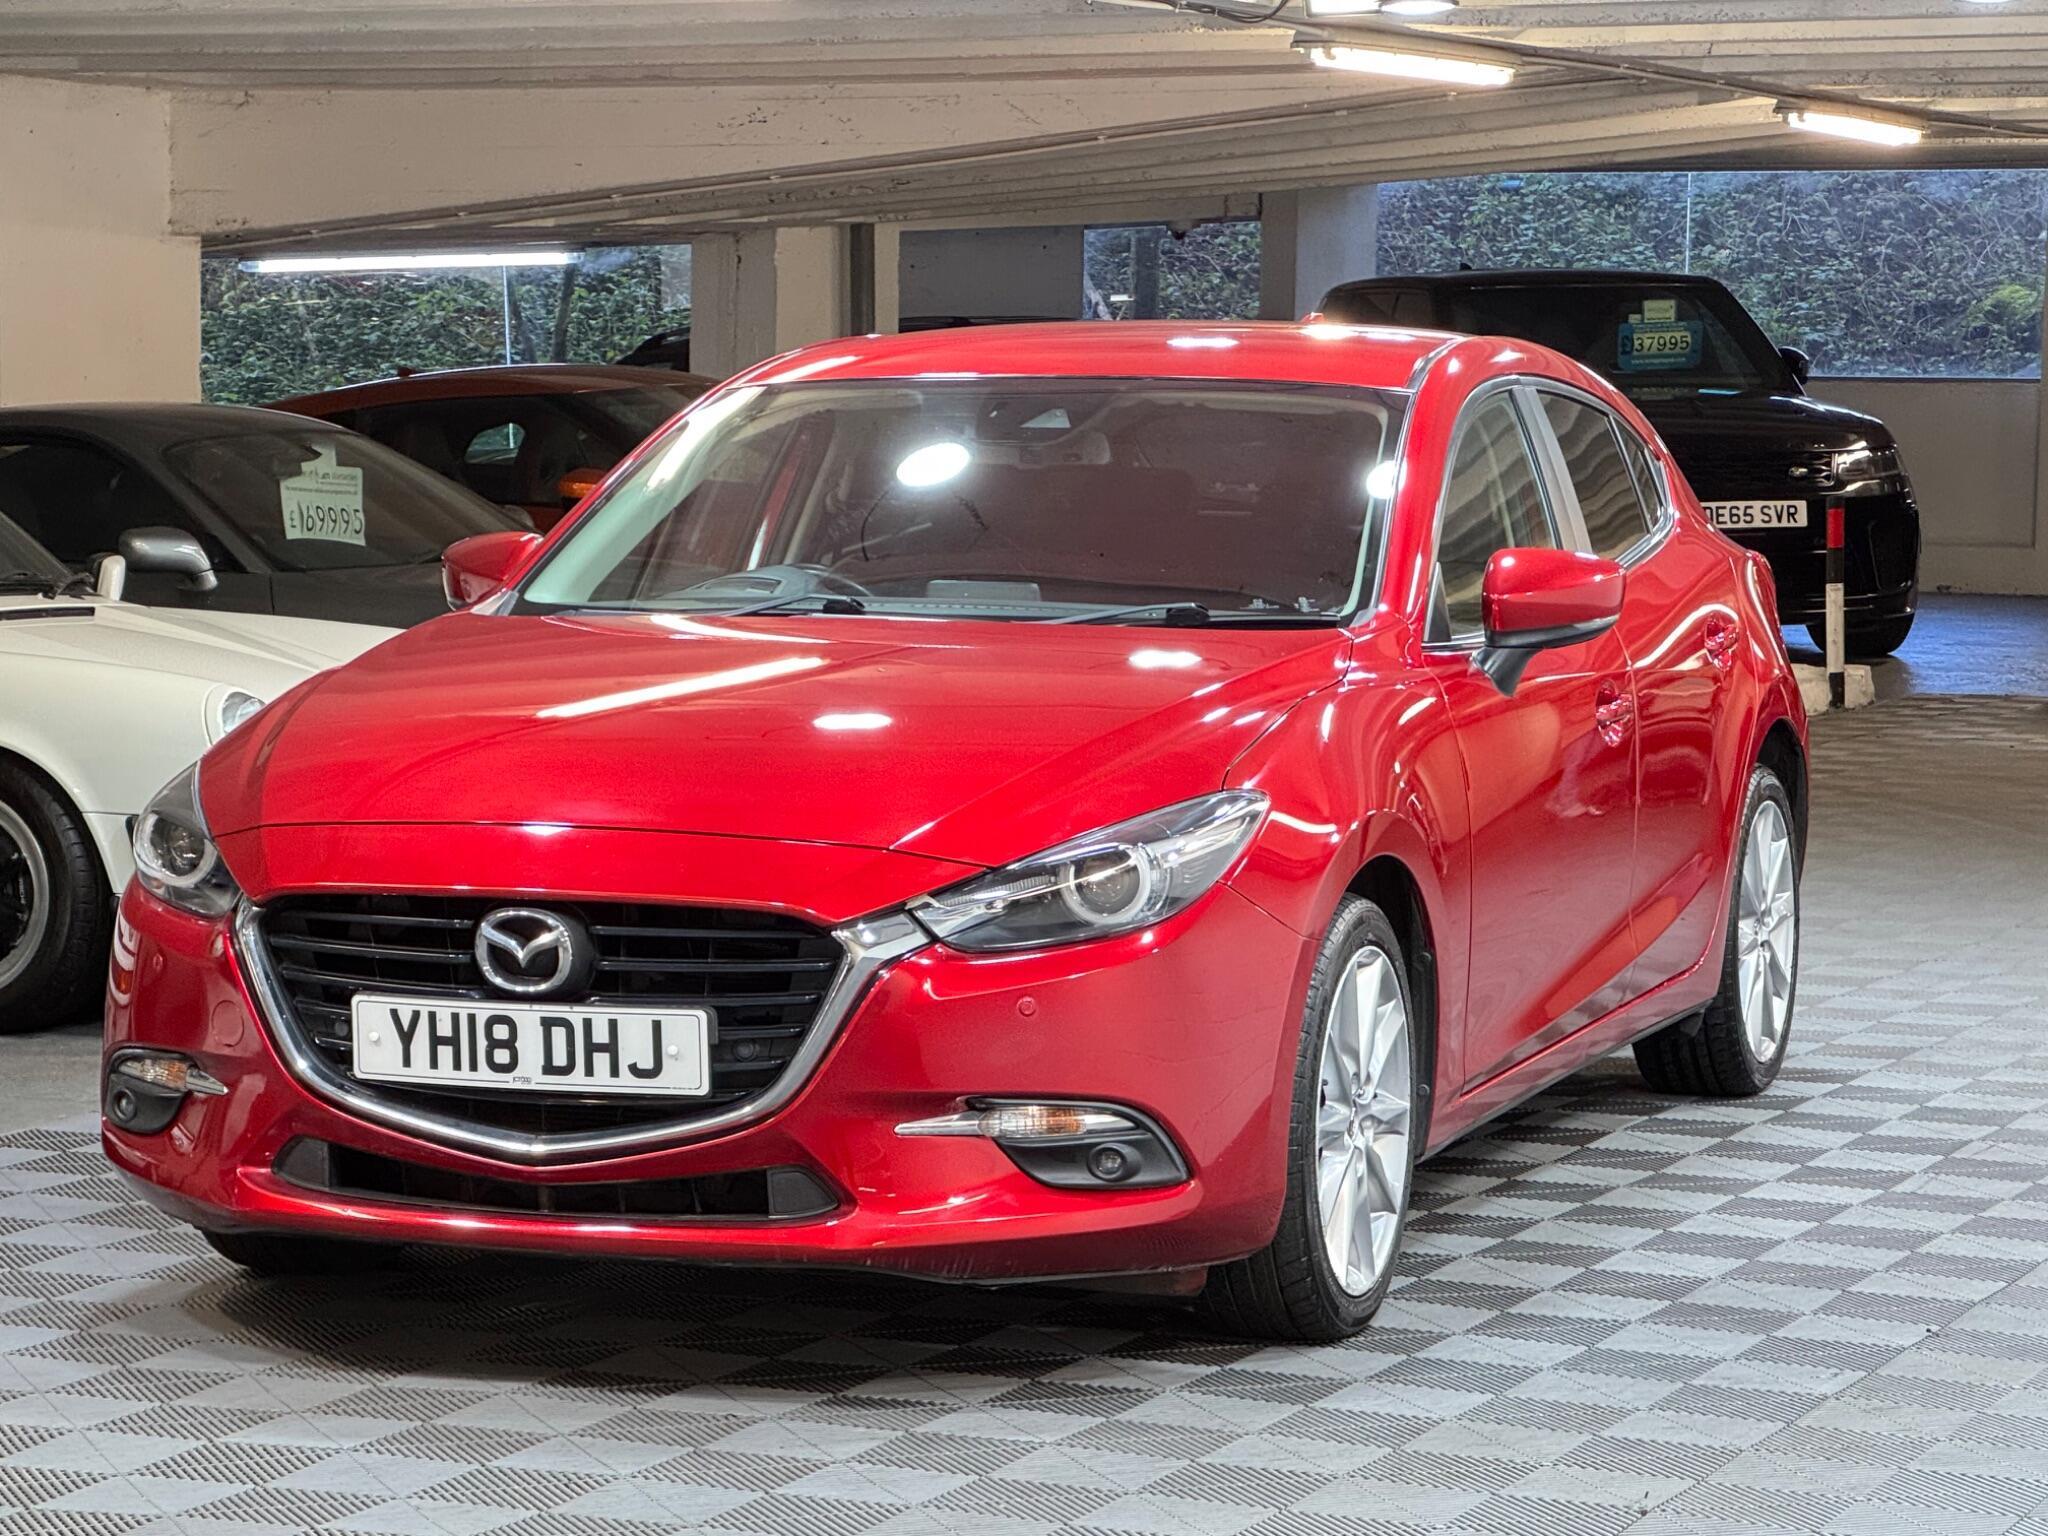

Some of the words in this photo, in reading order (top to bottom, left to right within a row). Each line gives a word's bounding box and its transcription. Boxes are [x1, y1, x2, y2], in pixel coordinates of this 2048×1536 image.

[1702, 505, 1754, 525] DE65
[1760, 504, 1798, 524] SVR
[389, 1008, 519, 1074] YH18
[540, 1015, 663, 1080] DHJ
